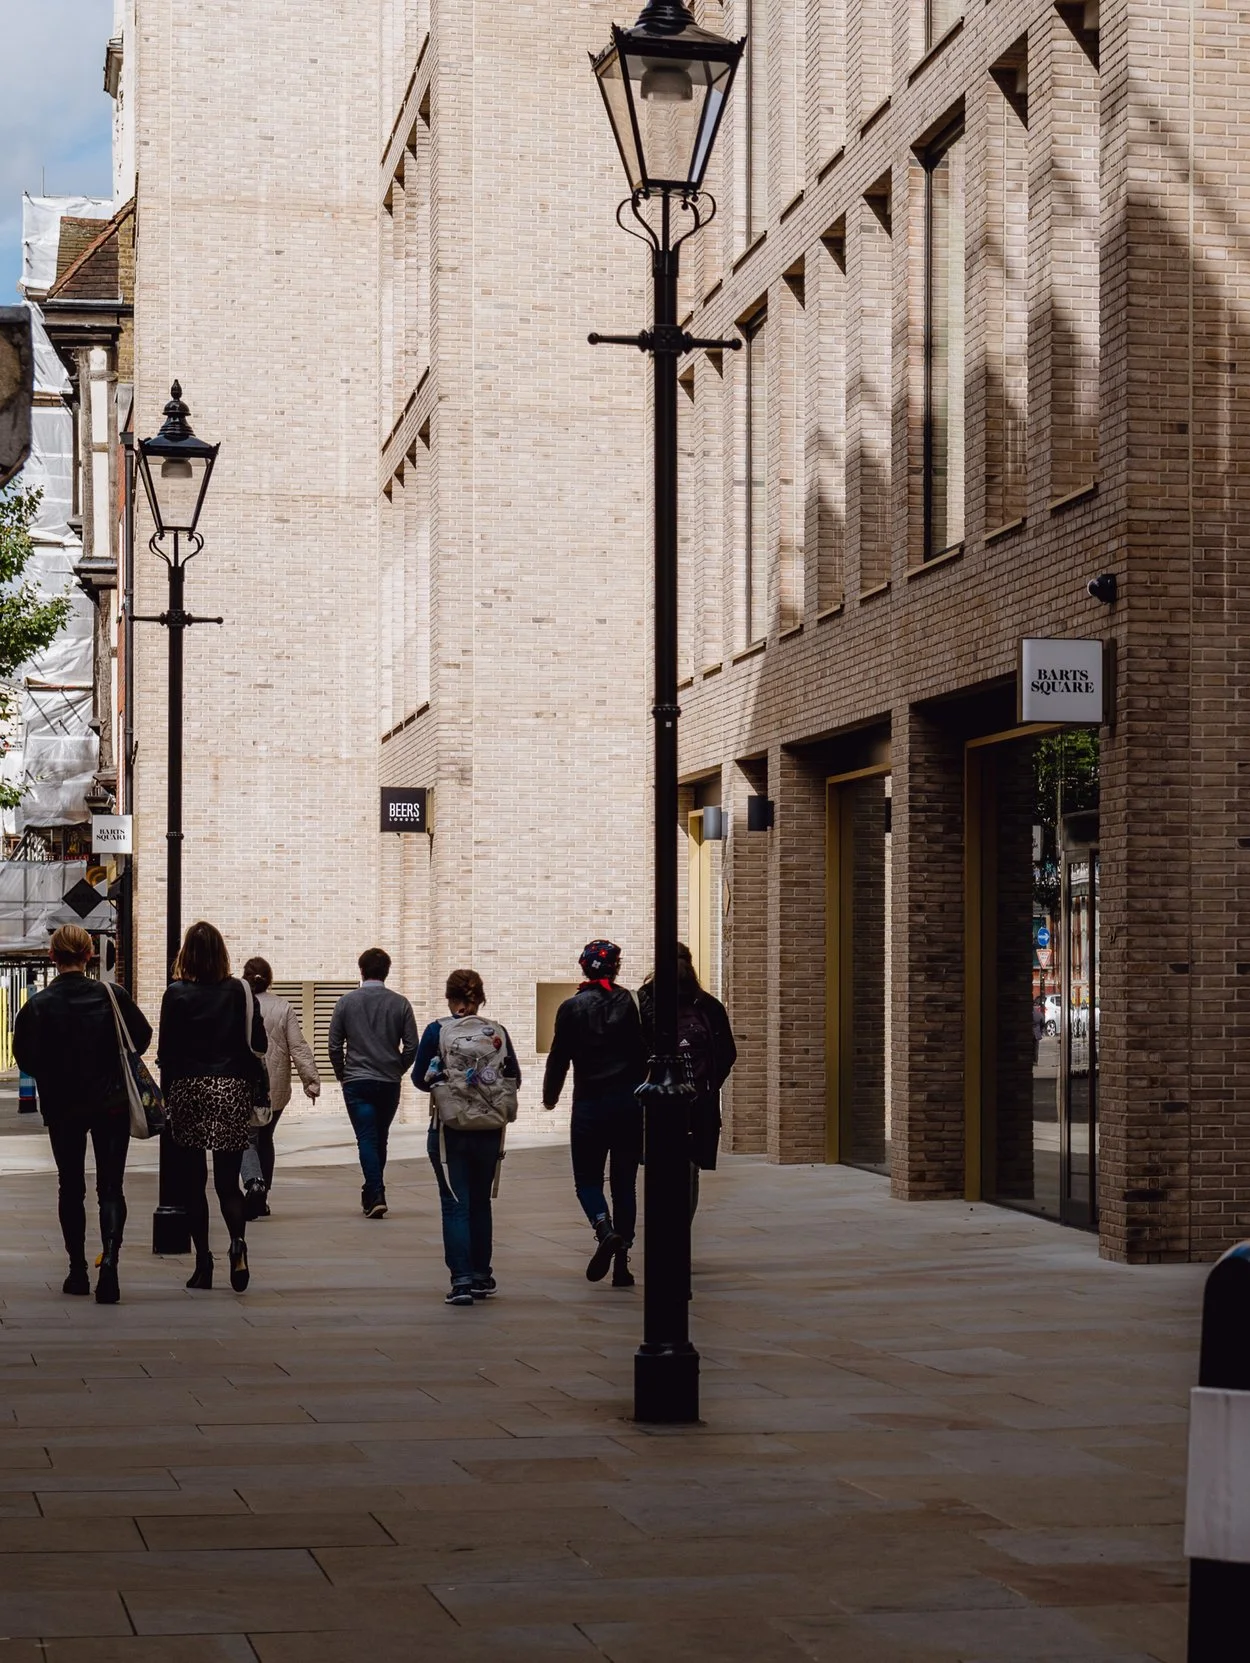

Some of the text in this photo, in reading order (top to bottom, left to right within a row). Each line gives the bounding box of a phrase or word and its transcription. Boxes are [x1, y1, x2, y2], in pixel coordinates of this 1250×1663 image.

[1037, 669, 1089, 681] BARTS
[1030, 680, 1095, 696] SQUARE
[389, 802, 420, 817] BEERS
[96, 834, 128, 842] SQUARE
